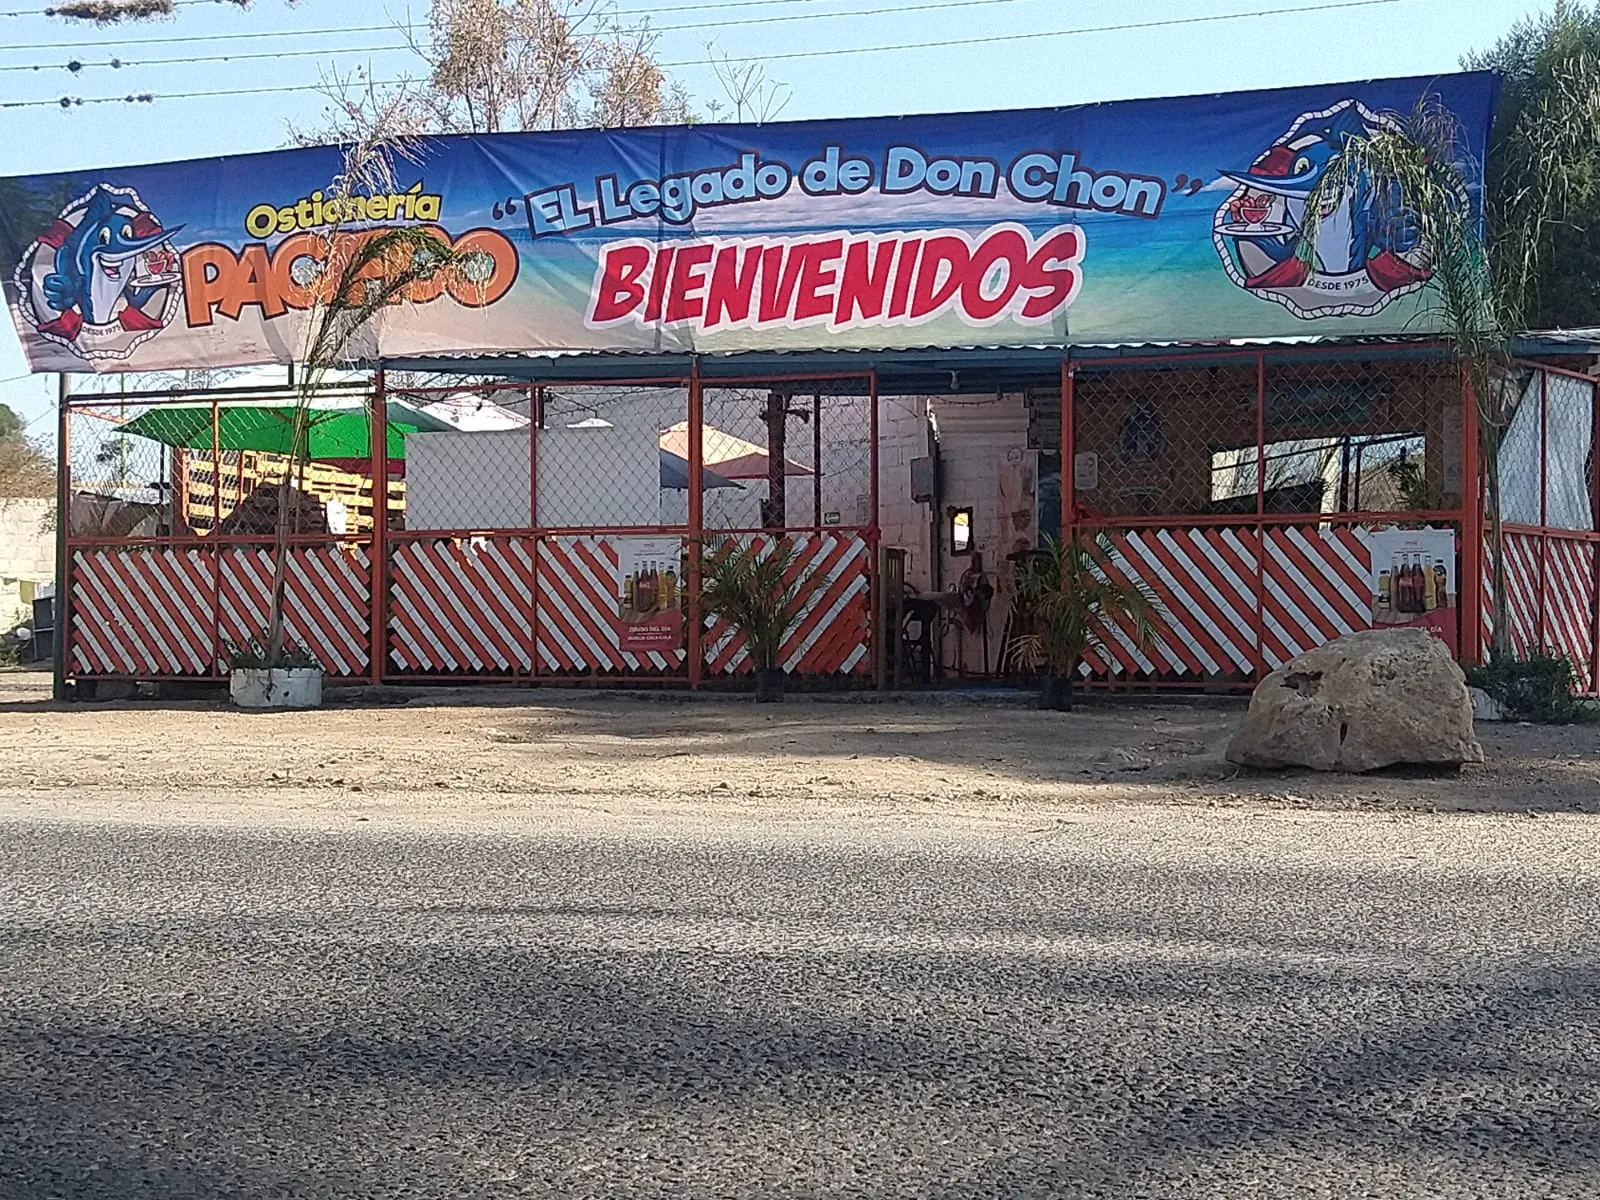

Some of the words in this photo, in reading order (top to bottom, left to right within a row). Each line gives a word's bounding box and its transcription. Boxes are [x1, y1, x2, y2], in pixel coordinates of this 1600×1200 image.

[246, 182, 441, 238] Ostionería
[597, 151, 792, 225] Legado
[800, 144, 874, 196] de
[881, 145, 998, 199] Don
[590, 228, 1079, 327] BIENVENIDOS
[1307, 278, 1341, 290] DESDE
[1343, 276, 1369, 289] 1975
